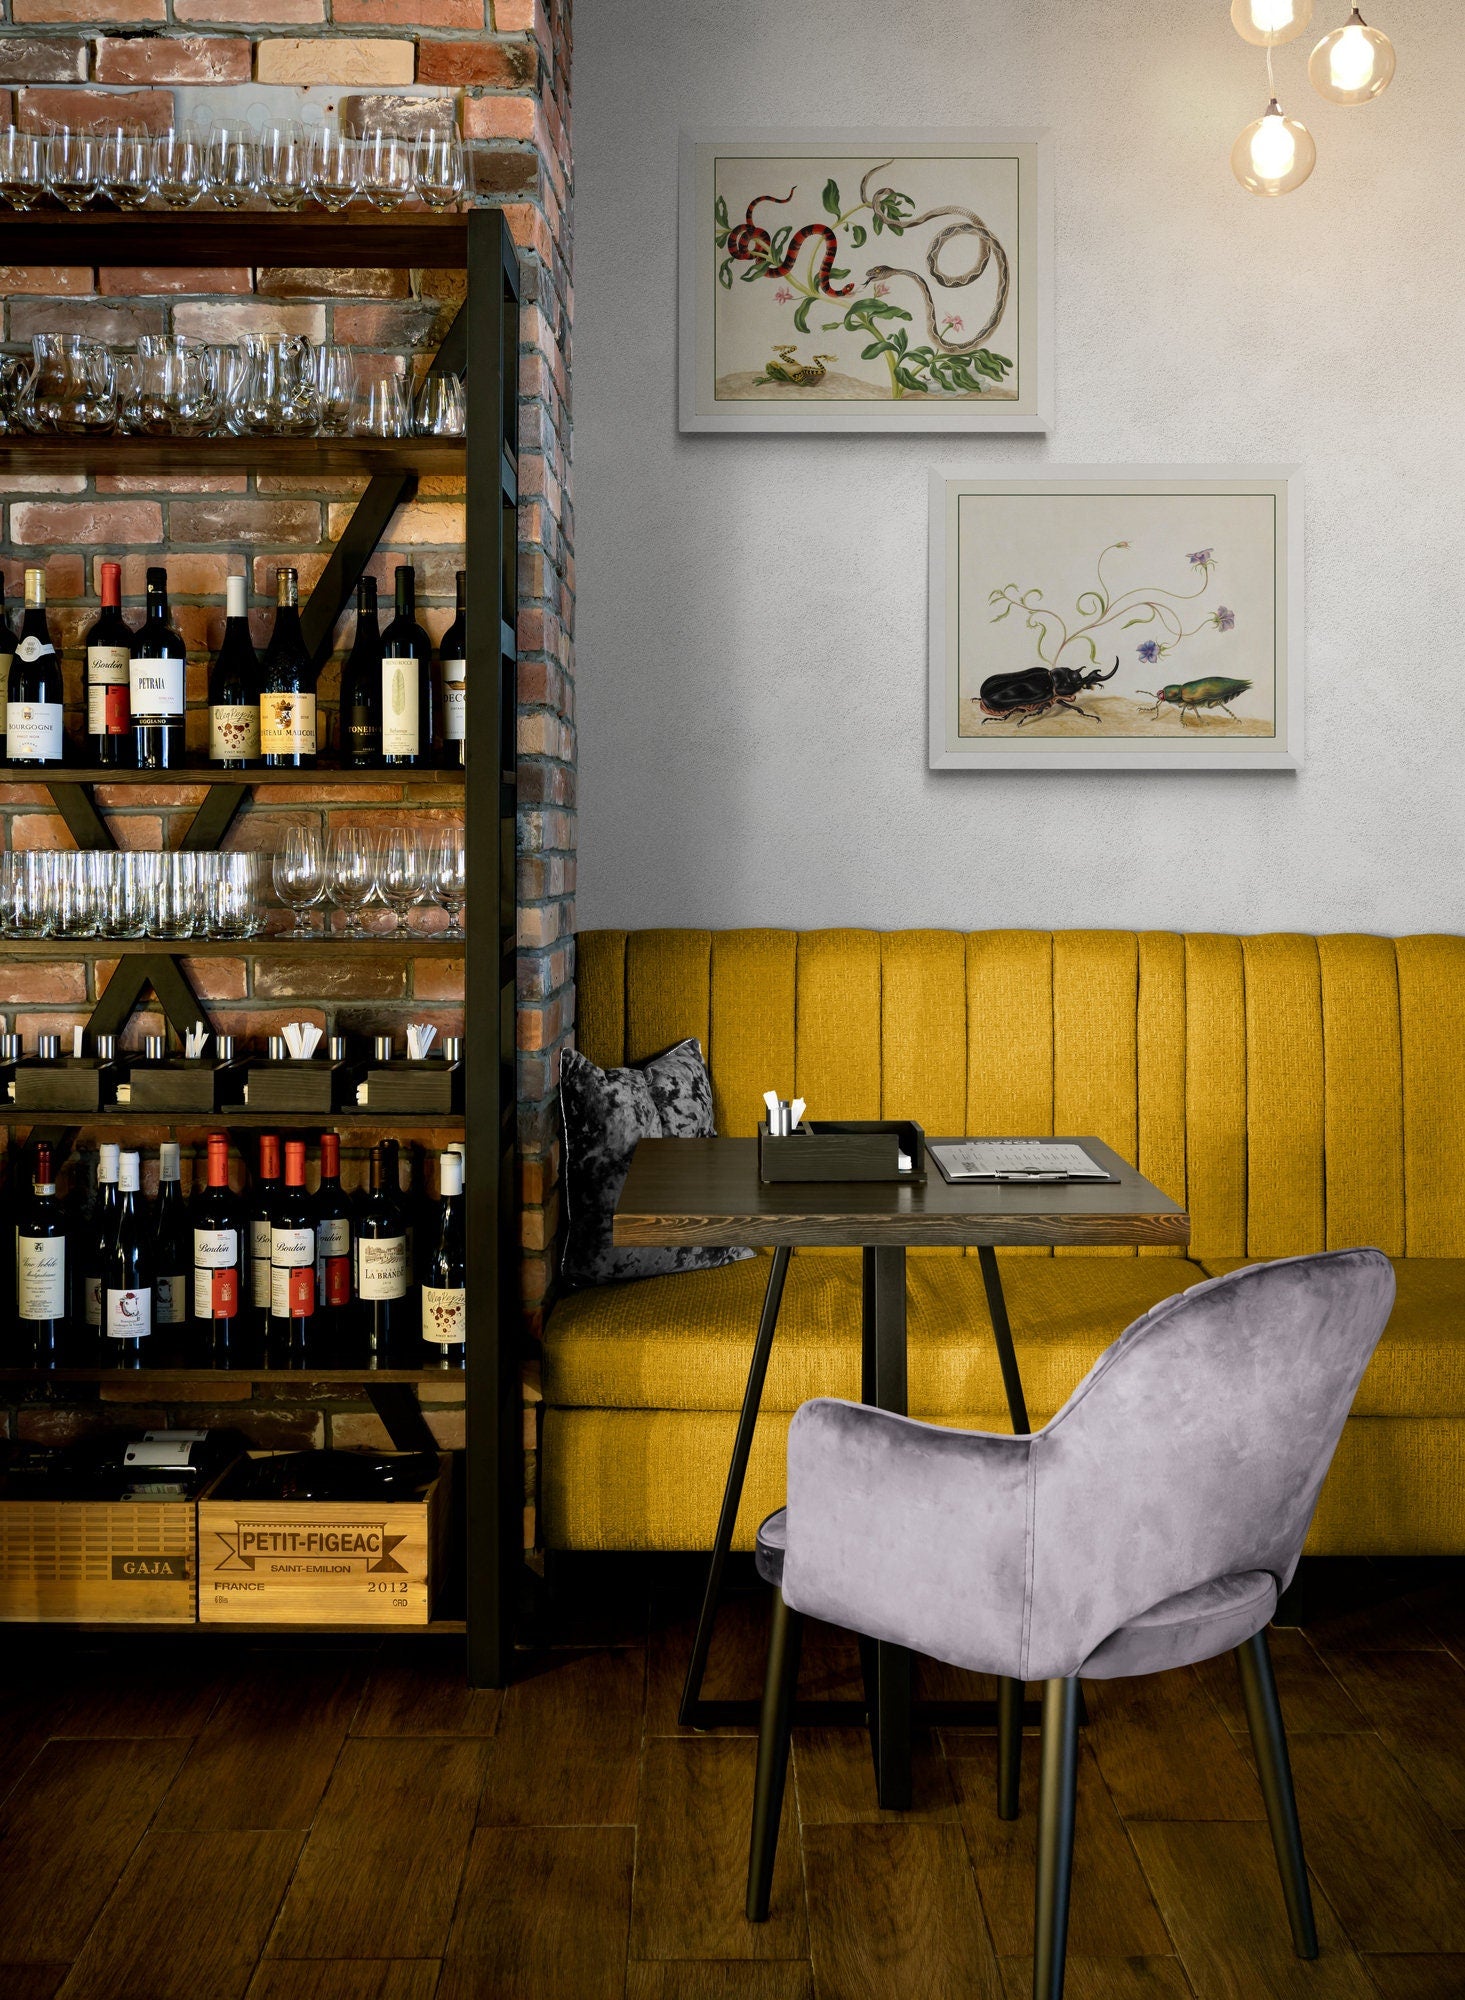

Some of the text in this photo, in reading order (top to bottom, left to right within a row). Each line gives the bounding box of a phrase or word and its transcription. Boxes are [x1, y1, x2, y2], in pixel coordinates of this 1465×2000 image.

[92, 660, 122, 669] Bordón
[139, 678, 165, 689] PETRAIA
[443, 693, 465, 702] DEC
[320, 1230, 343, 1241] ordón
[200, 1242, 229, 1252] Bordón
[277, 1242, 306, 1252] Bordón
[243, 1532, 380, 1552] PETIT-FIGEAC
[123, 1561, 174, 1576] GAJA
[270, 1564, 351, 1573] SAINT-EMILION
[214, 1582, 265, 1591] FRANCE
[367, 1582, 408, 1593] 2012
[392, 1599, 408, 1607] CRD
